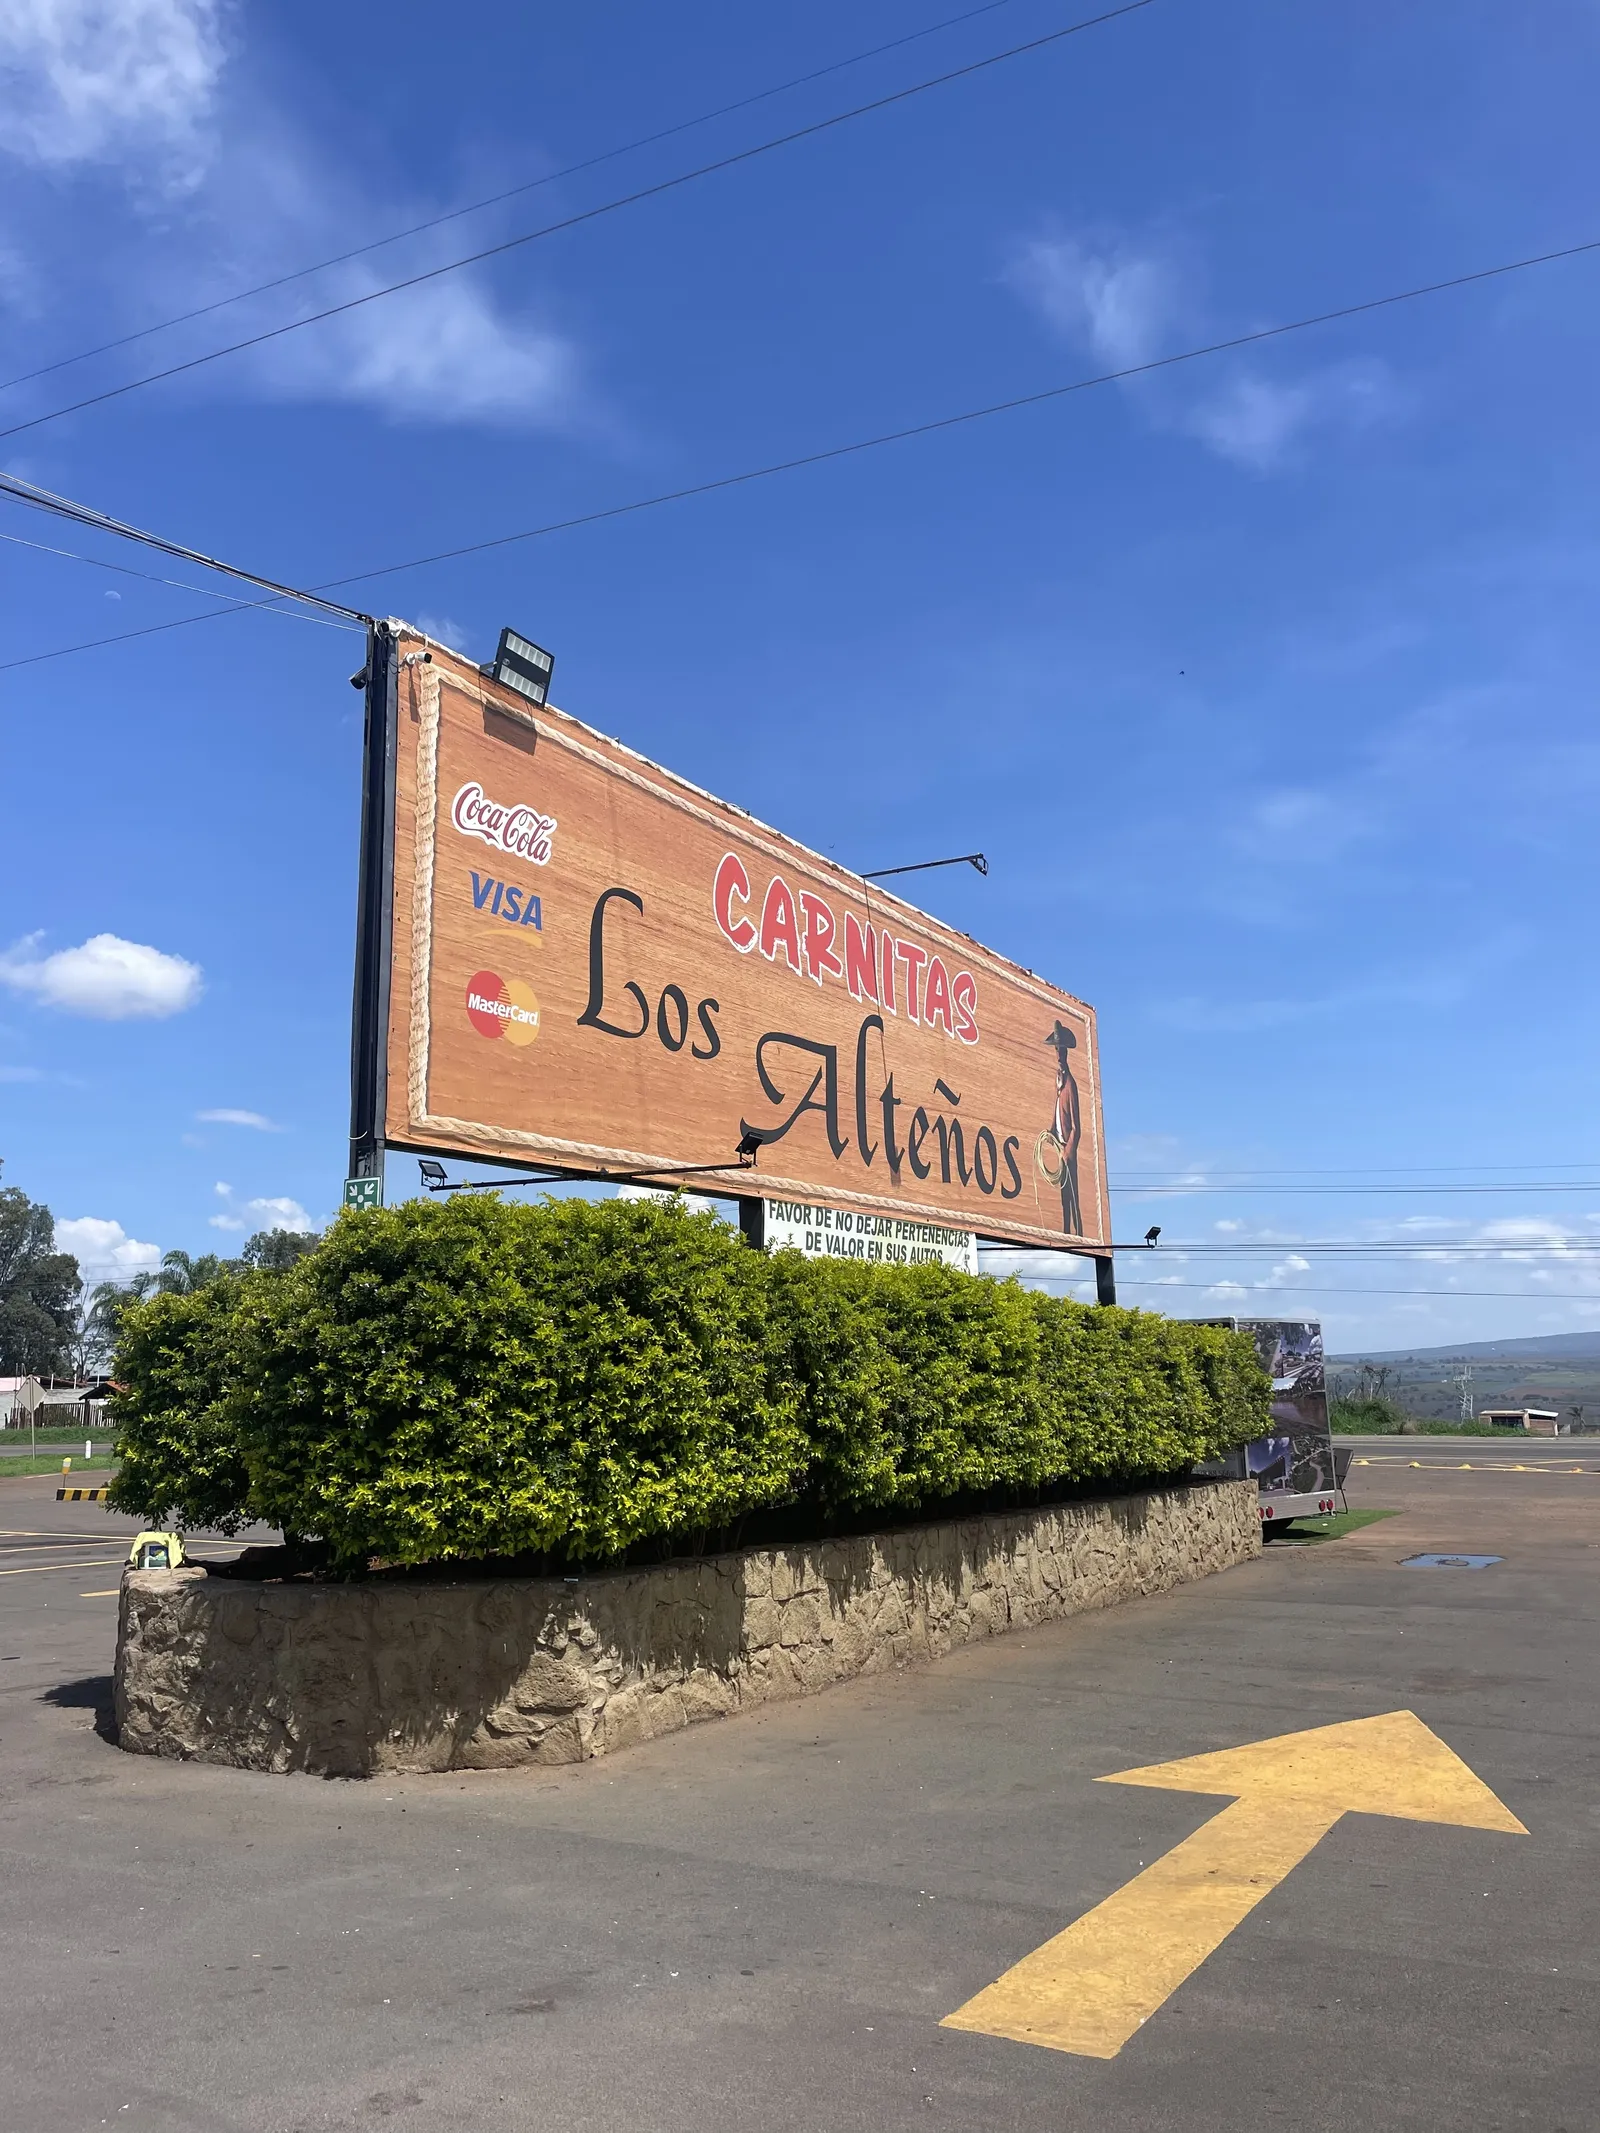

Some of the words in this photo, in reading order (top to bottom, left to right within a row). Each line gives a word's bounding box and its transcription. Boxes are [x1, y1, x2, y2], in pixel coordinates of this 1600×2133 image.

[455, 786, 553, 862] Coca-Cola
[468, 870, 542, 931] VISA
[576, 887, 721, 1060] Los
[713, 852, 979, 1045] CARNITAS
[467, 992, 539, 1027] MasterCard
[740, 1015, 1021, 1199] Alteños
[769, 1200, 812, 1225] FAVOR
[815, 1207, 832, 1229] DE
[836, 1211, 853, 1232] NO
[856, 1215, 893, 1238] DEJAR
[895, 1221, 970, 1248] PERTENENCIAS
[805, 1230, 822, 1252] DE
[825, 1233, 865, 1258] VALOR
[867, 1240, 883, 1260] EN
[886, 1243, 907, 1262] SUS
[909, 1246, 943, 1265] AUTOS
